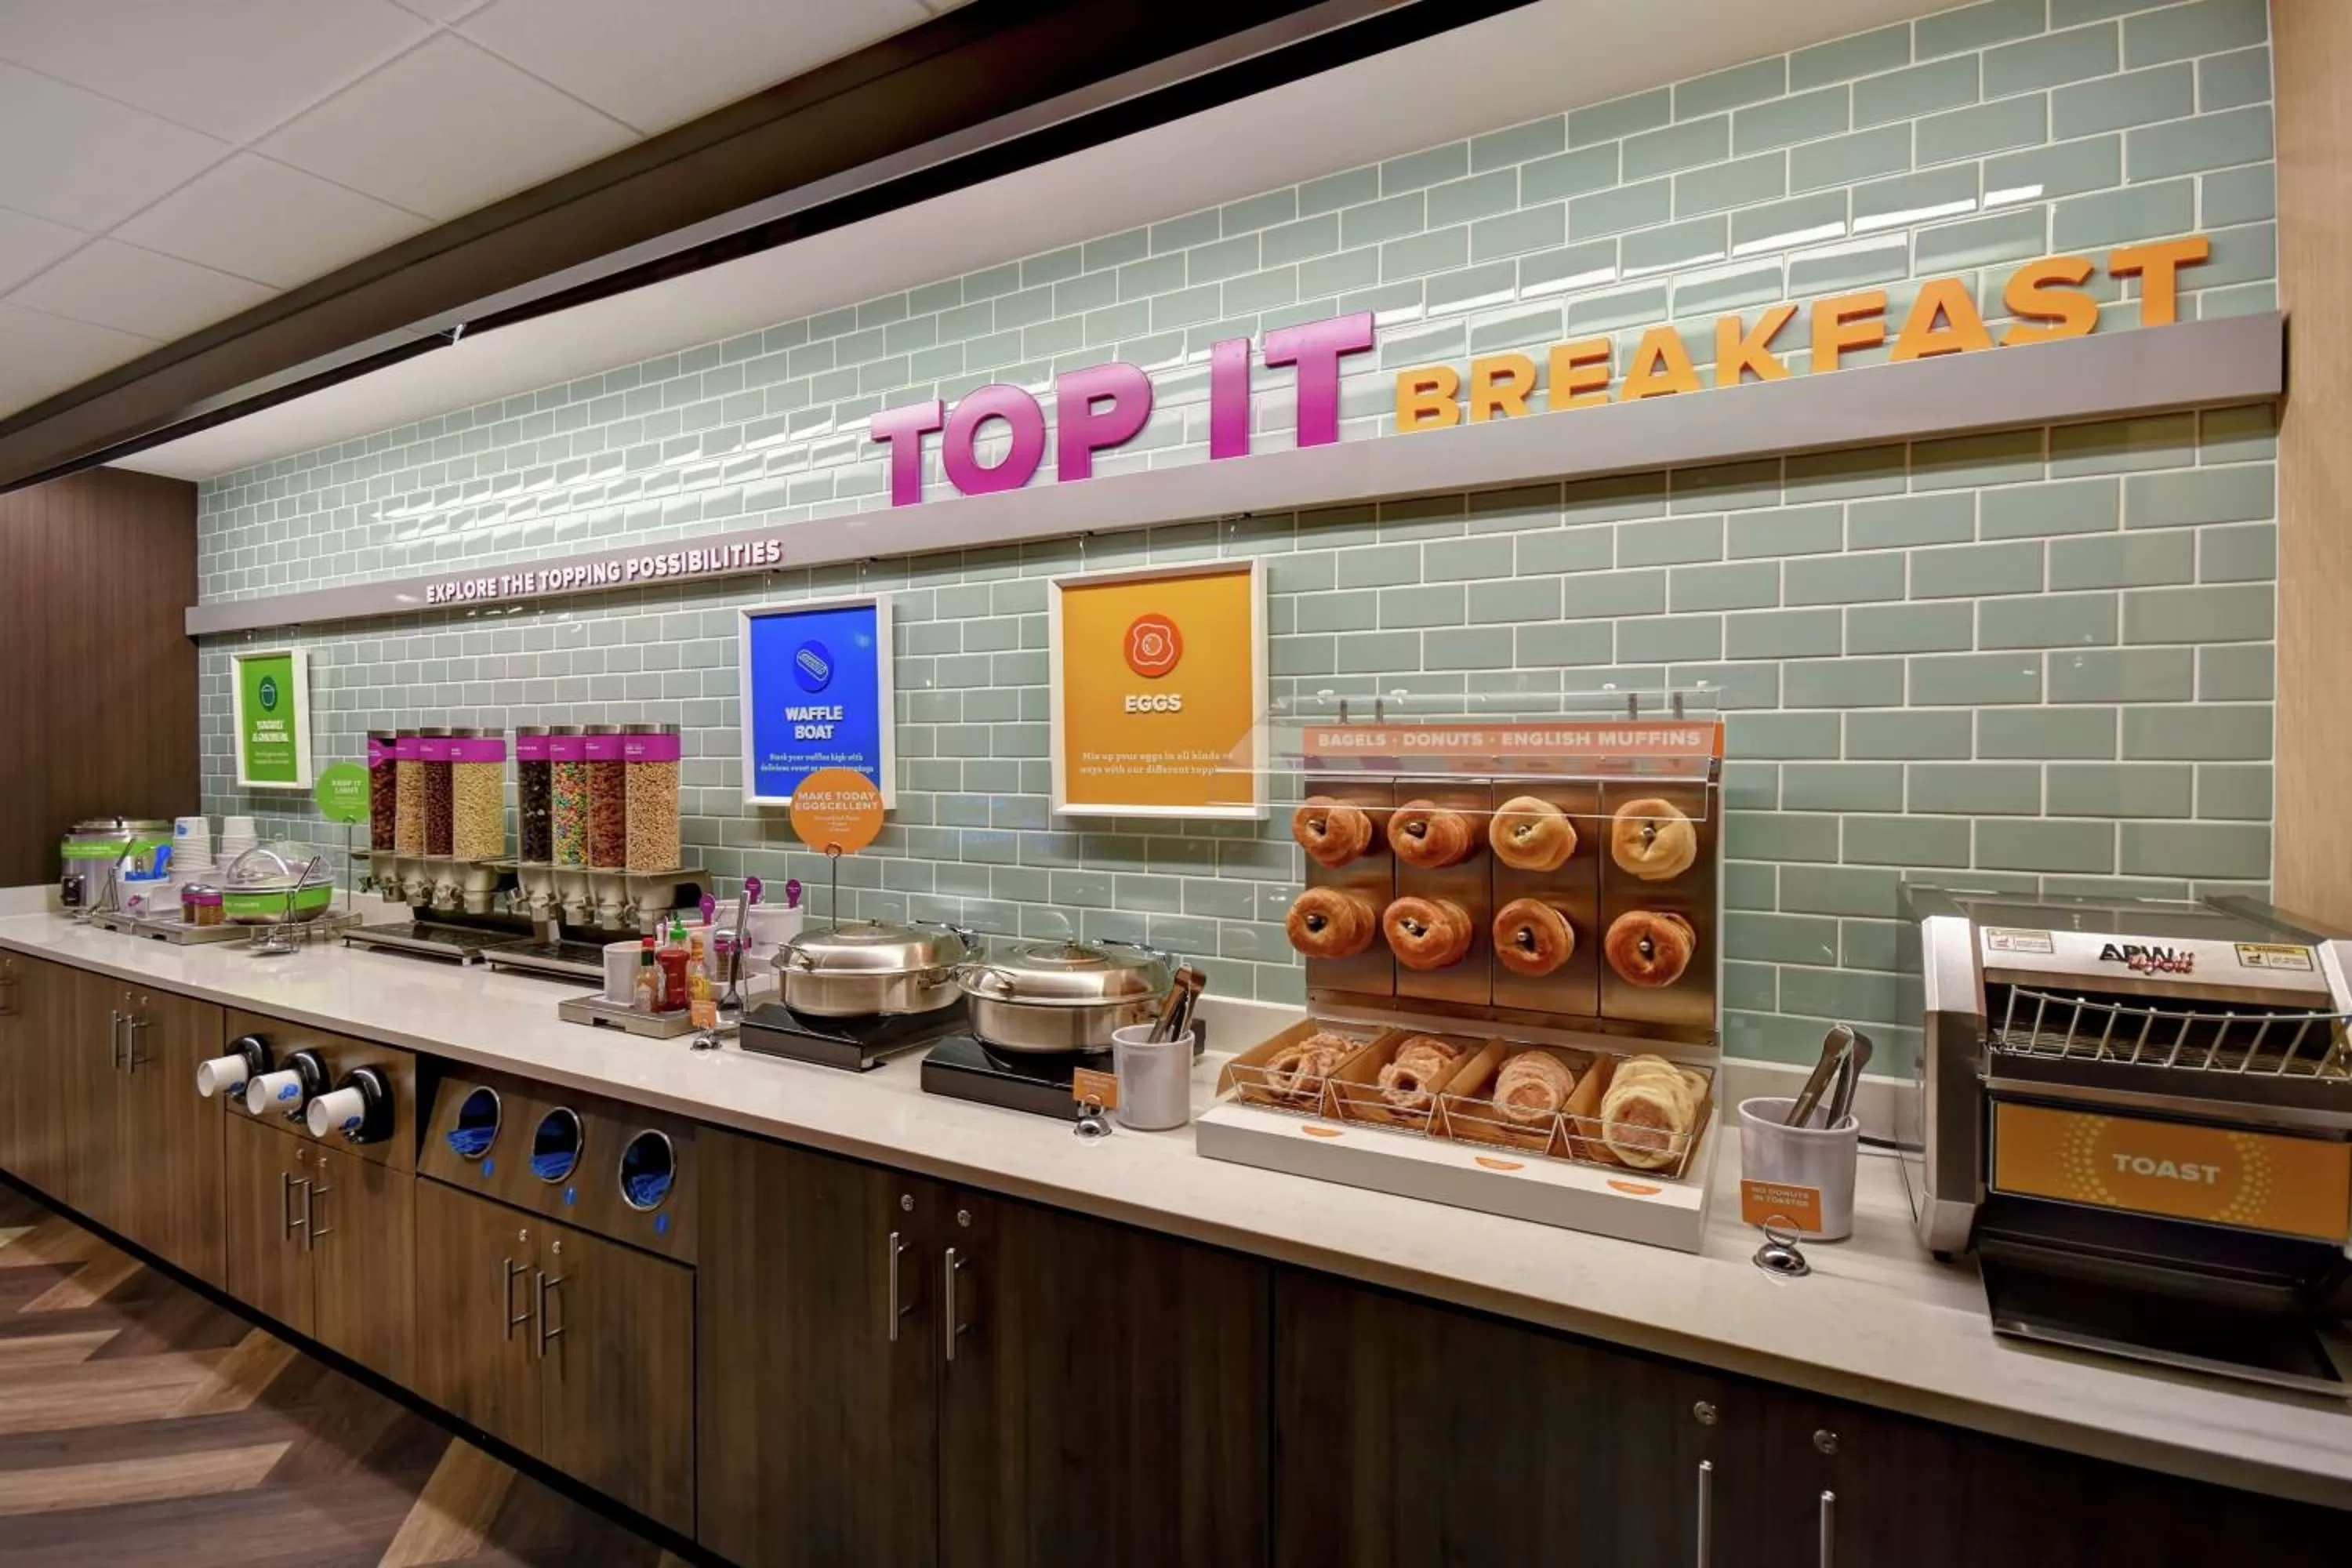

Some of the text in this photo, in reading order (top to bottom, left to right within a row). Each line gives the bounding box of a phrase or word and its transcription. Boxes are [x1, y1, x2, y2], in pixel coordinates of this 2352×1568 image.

[870, 234, 2210, 507] TOP IT BREAKFAST
[426, 539, 782, 604] EXPLORE THE TOPPING POSSIBILITIES
[1125, 694, 1182, 713] EGGS
[785, 705, 844, 721] WAFFLE
[794, 724, 834, 740] BOAT
[1318, 729, 1700, 747] BAGELS DONUTS ENGLISH MUFFINS
[797, 791, 876, 800] MAKE TODAY
[794, 801, 879, 811] EGGSCELLENT
[2111, 1153, 2221, 1185] TOAST
